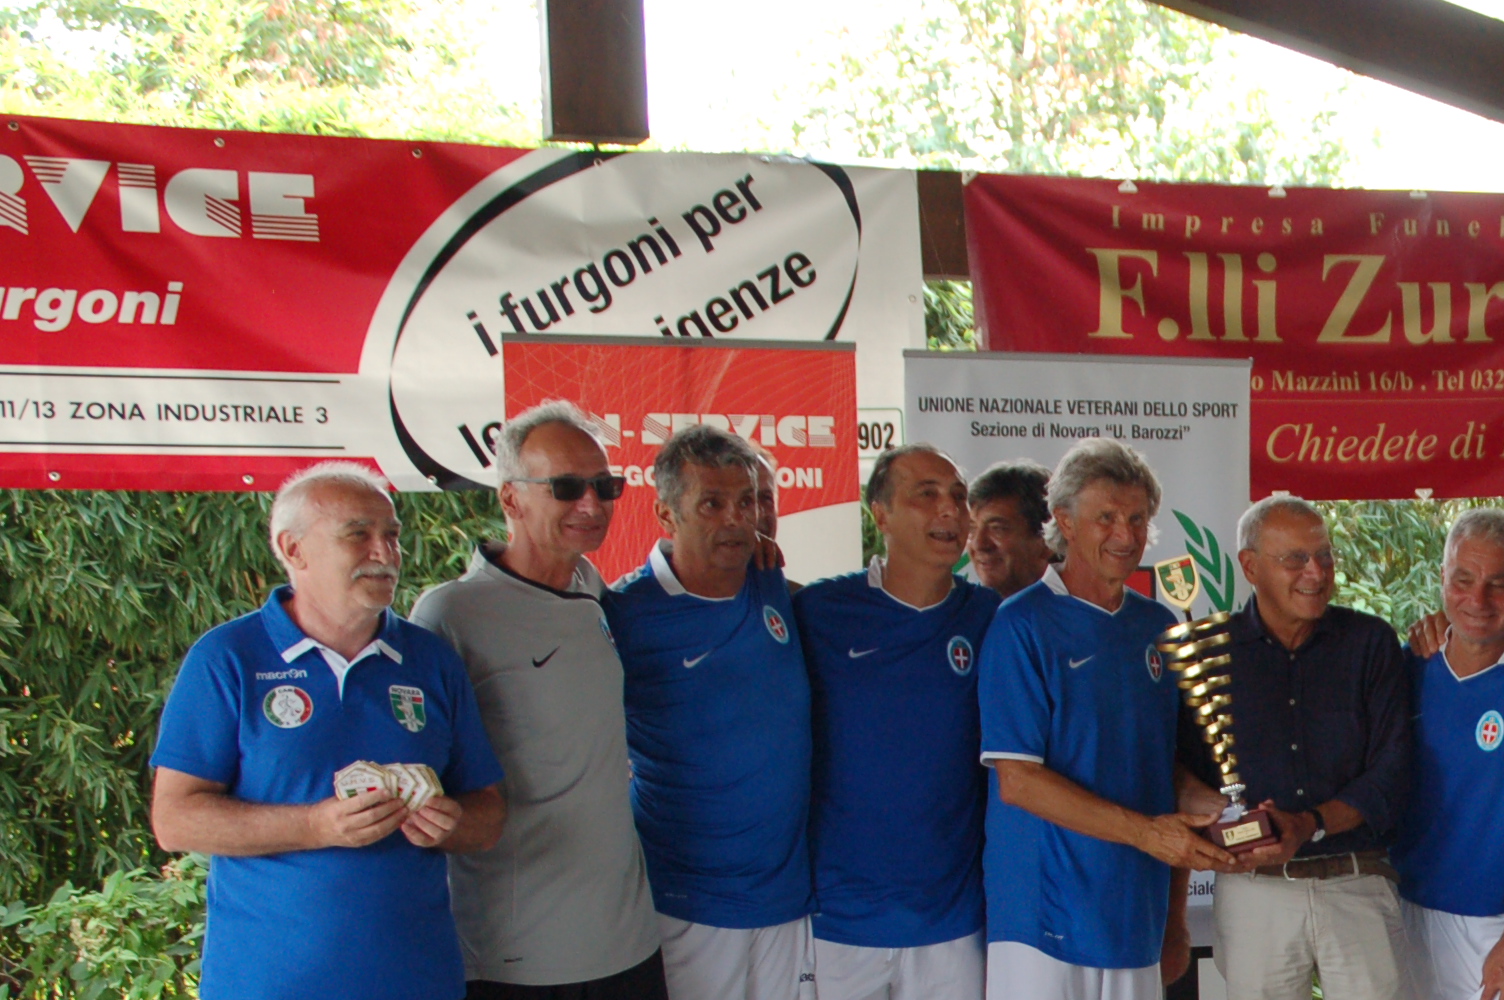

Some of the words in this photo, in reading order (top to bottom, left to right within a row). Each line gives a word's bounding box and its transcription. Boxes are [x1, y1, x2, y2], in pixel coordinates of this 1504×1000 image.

[1111, 204, 1325, 239] Impresa
[465, 308, 499, 358] i
[498, 216, 682, 334] furgoni
[681, 173, 763, 253] per
[0, 281, 183, 332] rgoni
[1084, 246, 1284, 343] F.lli
[1271, 369, 1361, 393] Mazzini
[1368, 370, 1414, 393] 16/b
[1432, 368, 1465, 392] Tel
[69, 401, 146, 421] ZONA
[157, 403, 304, 424] INDUSTRIALE
[315, 406, 329, 425] 3
[917, 396, 975, 414] UNIONE
[978, 397, 1063, 415] NAZIONALE
[1066, 399, 1138, 417] VETERANI
[1143, 401, 1188, 417] DELLO
[1192, 402, 1239, 418] SPORT
[970, 421, 1028, 438] Sezione
[1032, 422, 1046, 438] di
[1050, 422, 1101, 439] Novara
[1265, 422, 1439, 464] Chiedete
[1449, 420, 1488, 460] di
[255, 668, 309, 681] macron
